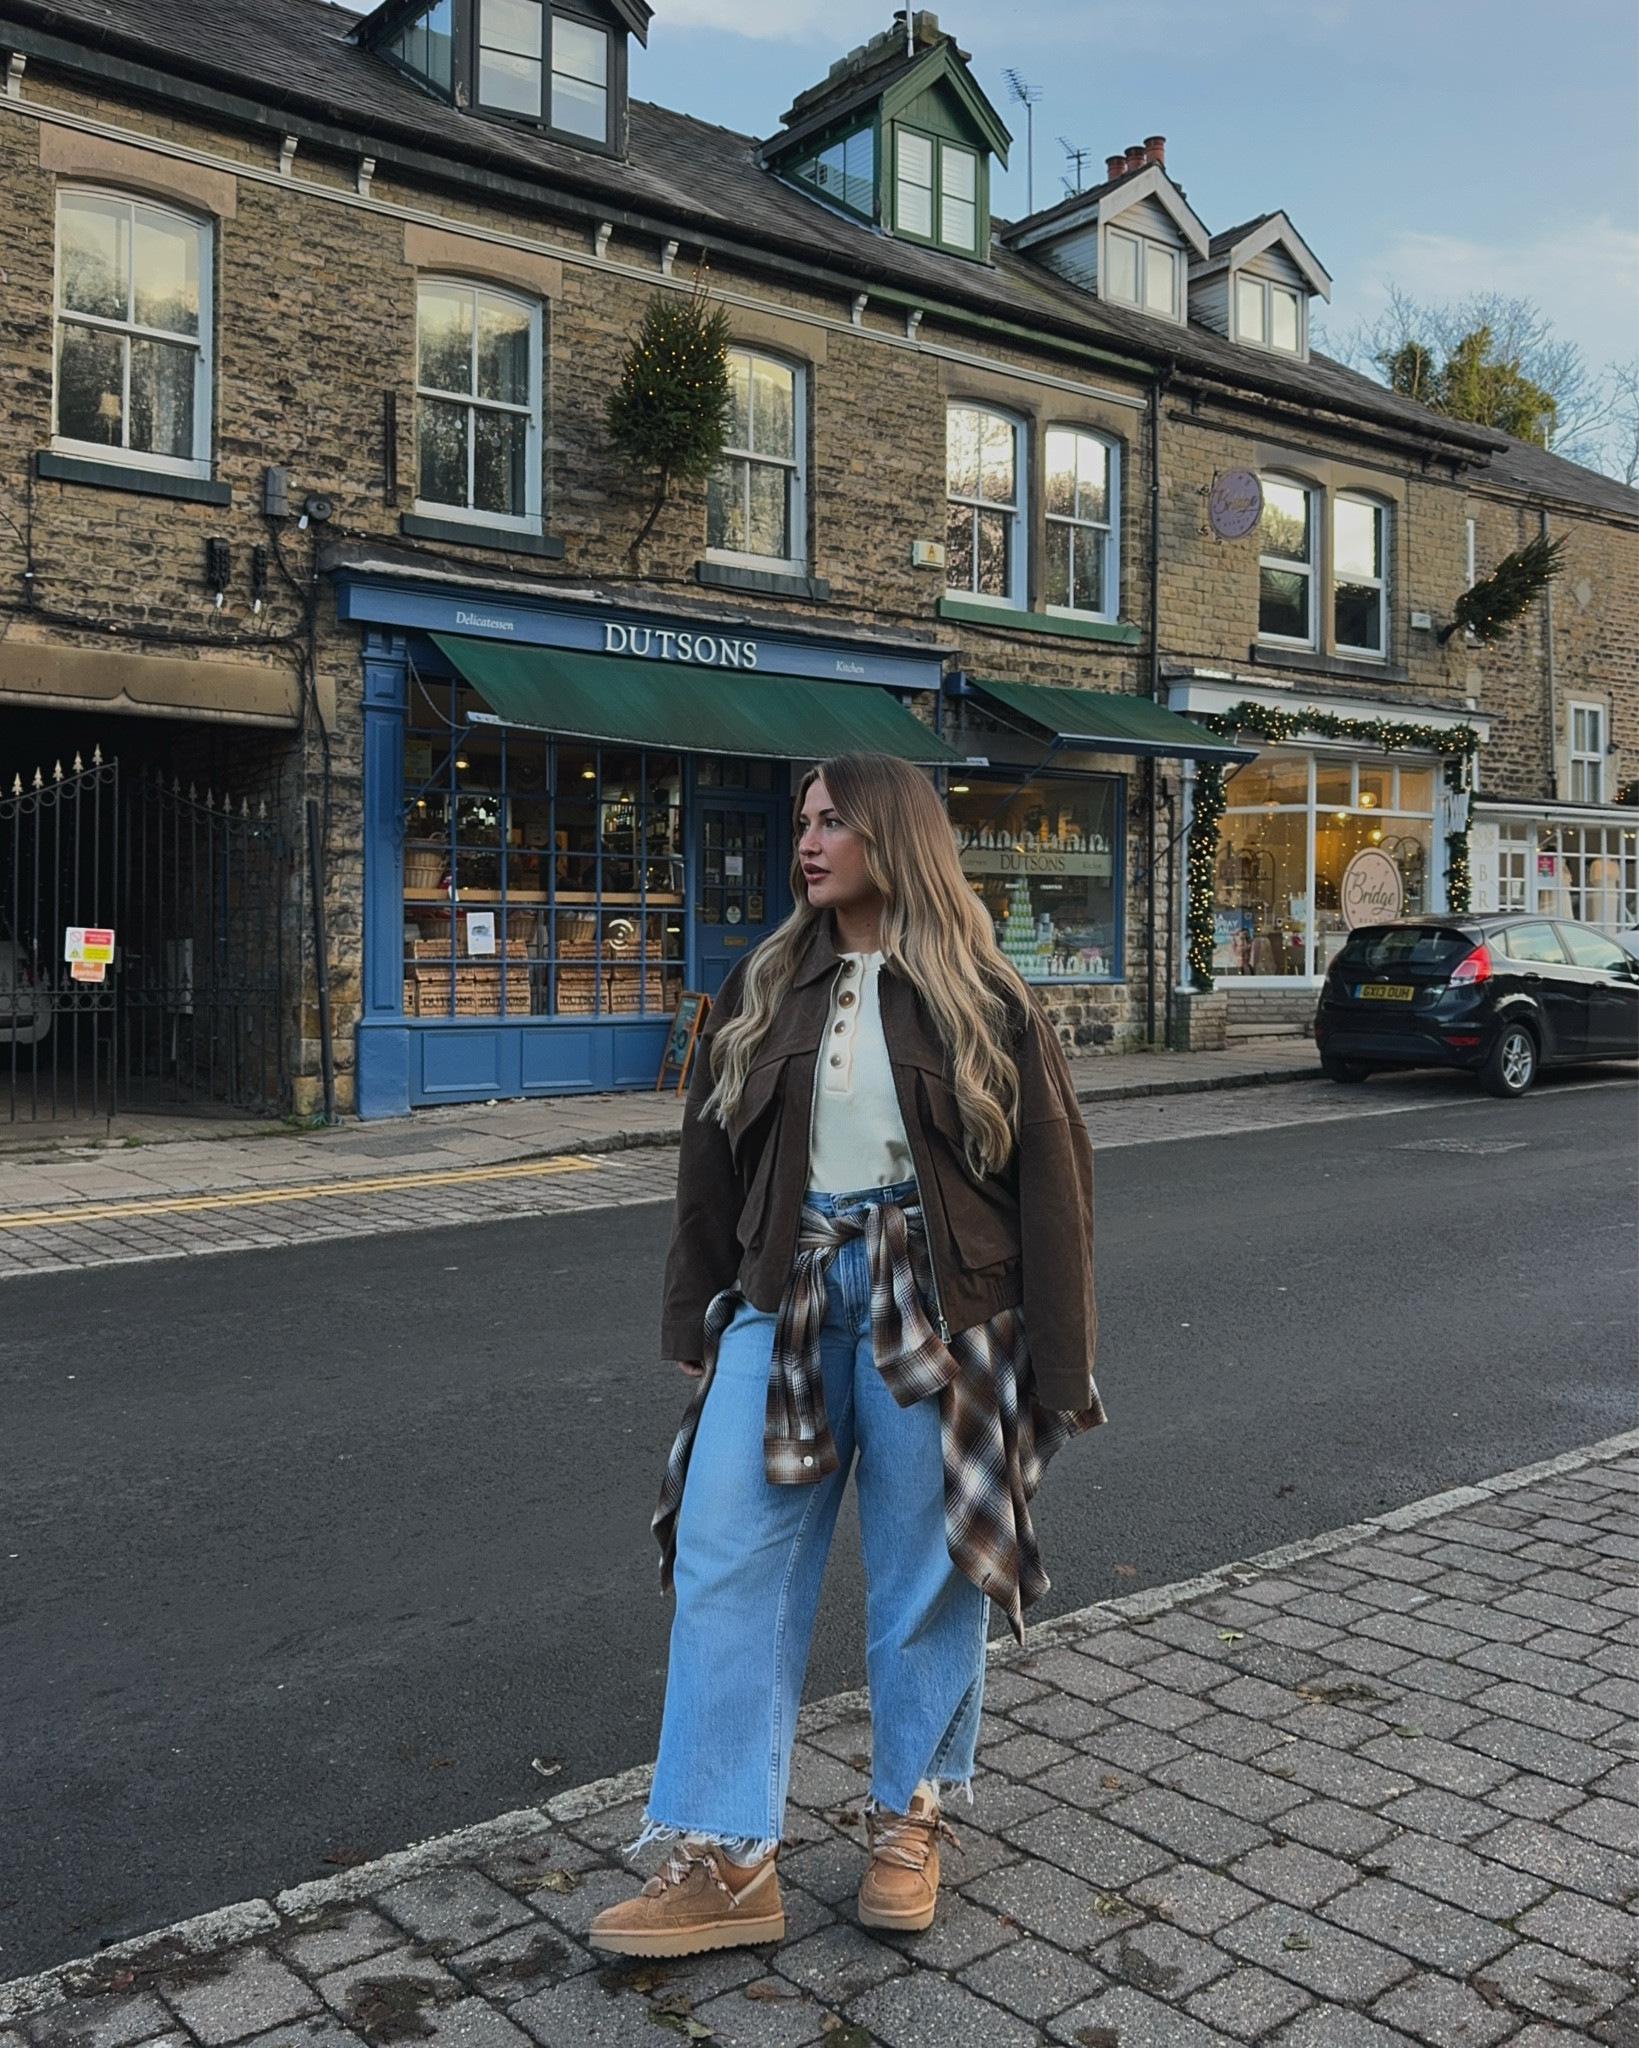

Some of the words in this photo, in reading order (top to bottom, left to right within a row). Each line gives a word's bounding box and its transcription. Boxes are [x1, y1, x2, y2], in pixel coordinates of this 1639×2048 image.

[456, 611, 514, 631] Delicatessen
[604, 623, 757, 668] DUTSONS
[836, 660, 864, 673] Kitchen
[1000, 854, 1065, 872] DUTSONS
[1348, 871, 1396, 916] Bridge
